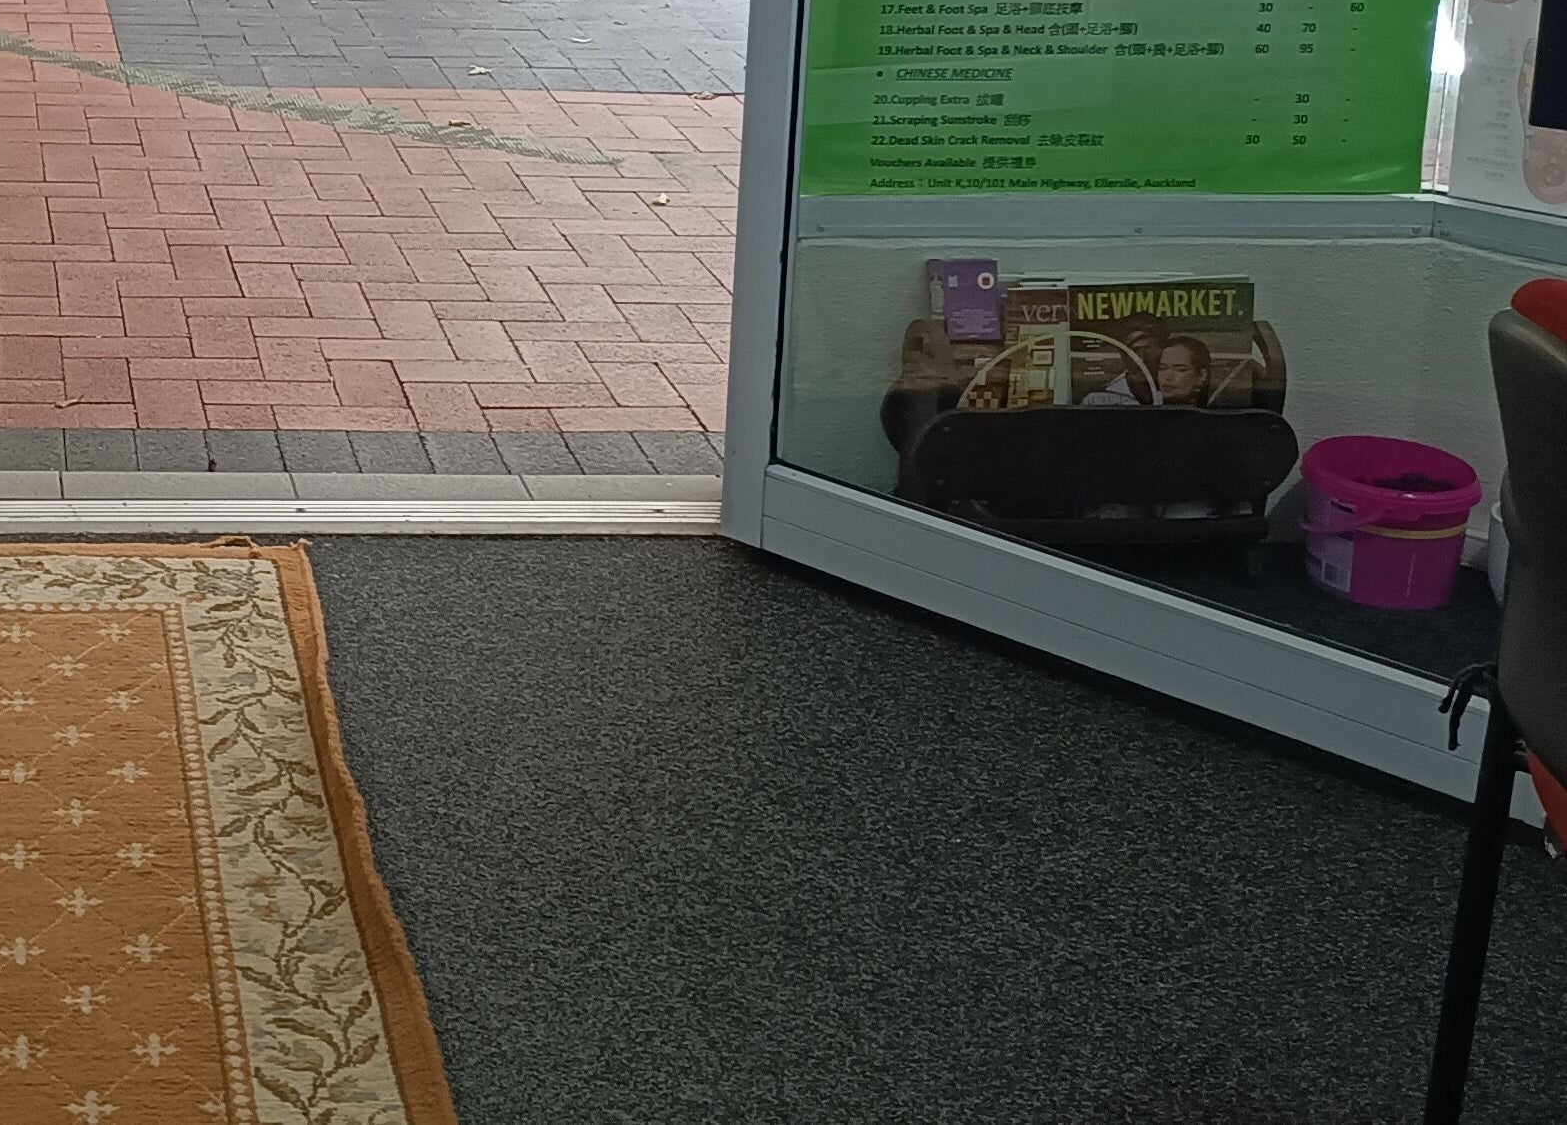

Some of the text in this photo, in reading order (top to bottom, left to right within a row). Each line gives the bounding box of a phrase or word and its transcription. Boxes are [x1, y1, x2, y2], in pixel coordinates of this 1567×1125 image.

[881, 3, 988, 16] 17.Feet Foot Spa
[1015, 23, 1045, 34] Head
[1014, 44, 1042, 55] Neck
[1057, 43, 1109, 55] Shoulder
[896, 67, 1014, 79] CHINESE MEDICINE
[1078, 288, 1245, 321] NEWMARKET.
